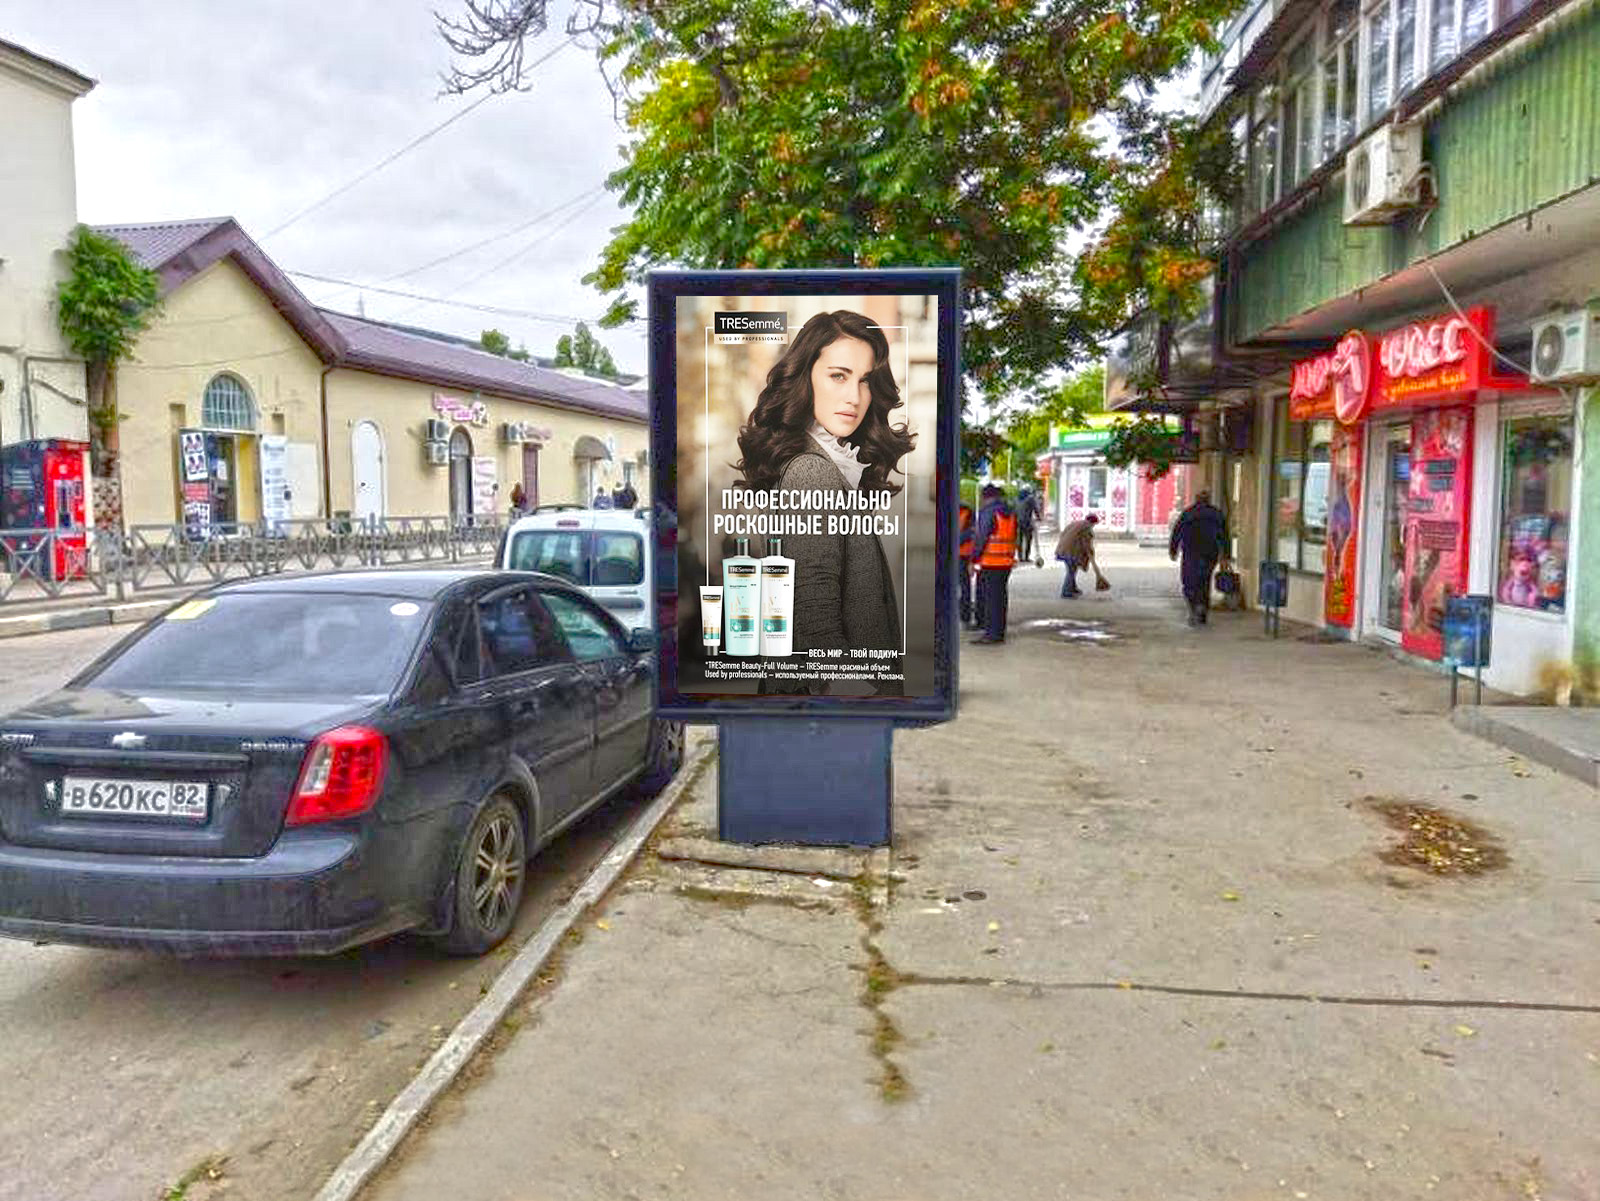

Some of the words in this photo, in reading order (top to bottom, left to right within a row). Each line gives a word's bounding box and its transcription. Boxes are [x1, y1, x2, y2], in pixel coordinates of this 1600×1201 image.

[719, 317, 781, 330] TRESemmé
[721, 489, 892, 511] ПРОФЕССИОНАЛЬНО
[713, 514, 823, 535] РОСКОШНЫЕ
[827, 514, 899, 536] ВОЛОСЫ
[808, 649, 826, 658] ВЕСЬ
[827, 649, 843, 658] МИР
[850, 648, 868, 658] ТВОЙ
[869, 649, 898, 659] ПОДИУМ
[741, 661, 775, 671] Beauty-Full
[776, 662, 799, 670] Volume
[839, 663, 870, 672] красивый
[705, 670, 720, 678] Used
[720, 670, 728, 679] by
[728, 670, 768, 679] professionals
[774, 671, 819, 681] используемый
